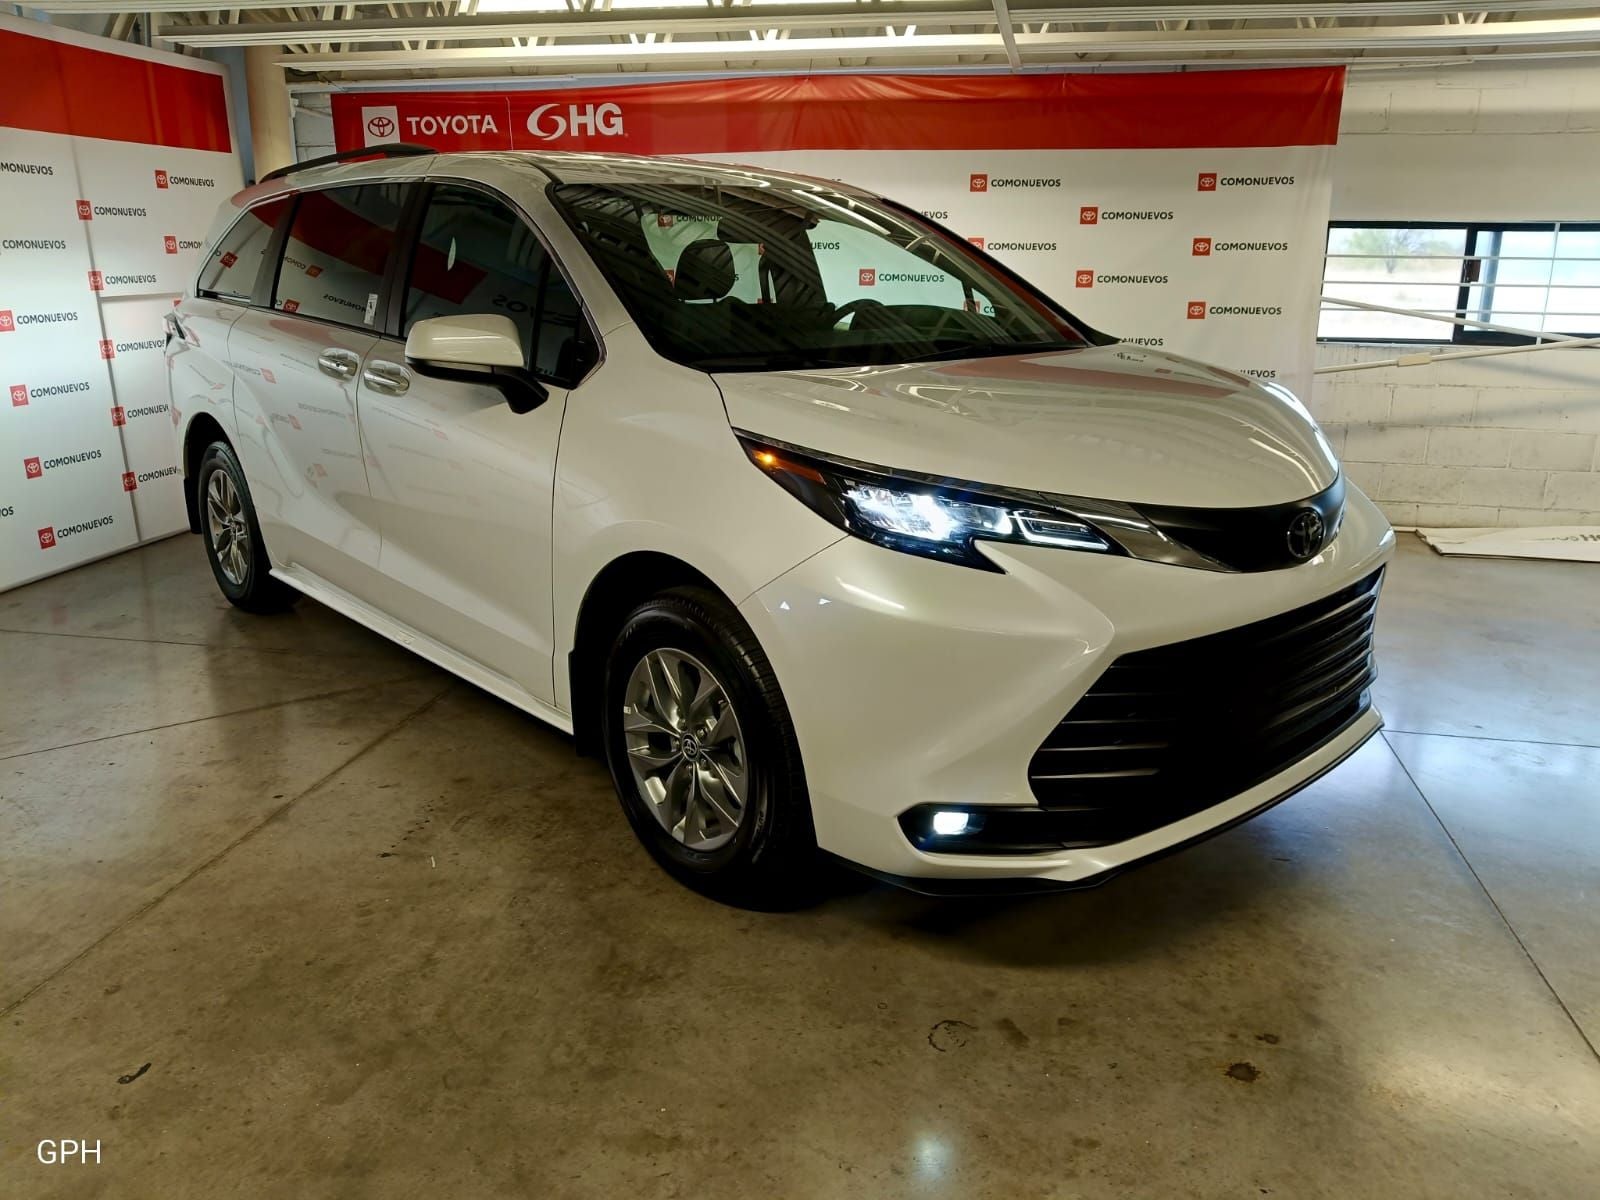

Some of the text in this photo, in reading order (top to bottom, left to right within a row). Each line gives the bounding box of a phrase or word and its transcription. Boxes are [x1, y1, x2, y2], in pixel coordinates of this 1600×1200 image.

[406, 114, 499, 136] TOYOTA
[0, 162, 53, 176] MONUEVOS
[170, 174, 215, 188] COMONUEVOS
[991, 178, 1061, 188] COMONUEVOS
[1220, 176, 1295, 187] COMONUEVOS
[94, 205, 147, 217] COMONUEVOS
[921, 210, 948, 220] EVOS
[1101, 211, 1174, 220] COMONUEVOS
[2, 238, 66, 251] COMONUEVOS
[987, 241, 1057, 251] COMONUEVOS
[1215, 242, 1288, 252] COMONUEVOS
[105, 274, 157, 285] COMONUEVOS
[878, 273, 945, 283] COMONUEVOS
[1097, 274, 1169, 284] COMONUEVOS
[1209, 305, 1282, 315] COMONUEVOS
[16, 312, 78, 326] COMONUEVOS
[30, 381, 90, 398] COMONUEVOS
[127, 404, 169, 419] COMONUEV
[43, 449, 102, 470] COMONUEVOS
[57, 516, 113, 538] COMONUEVOS
